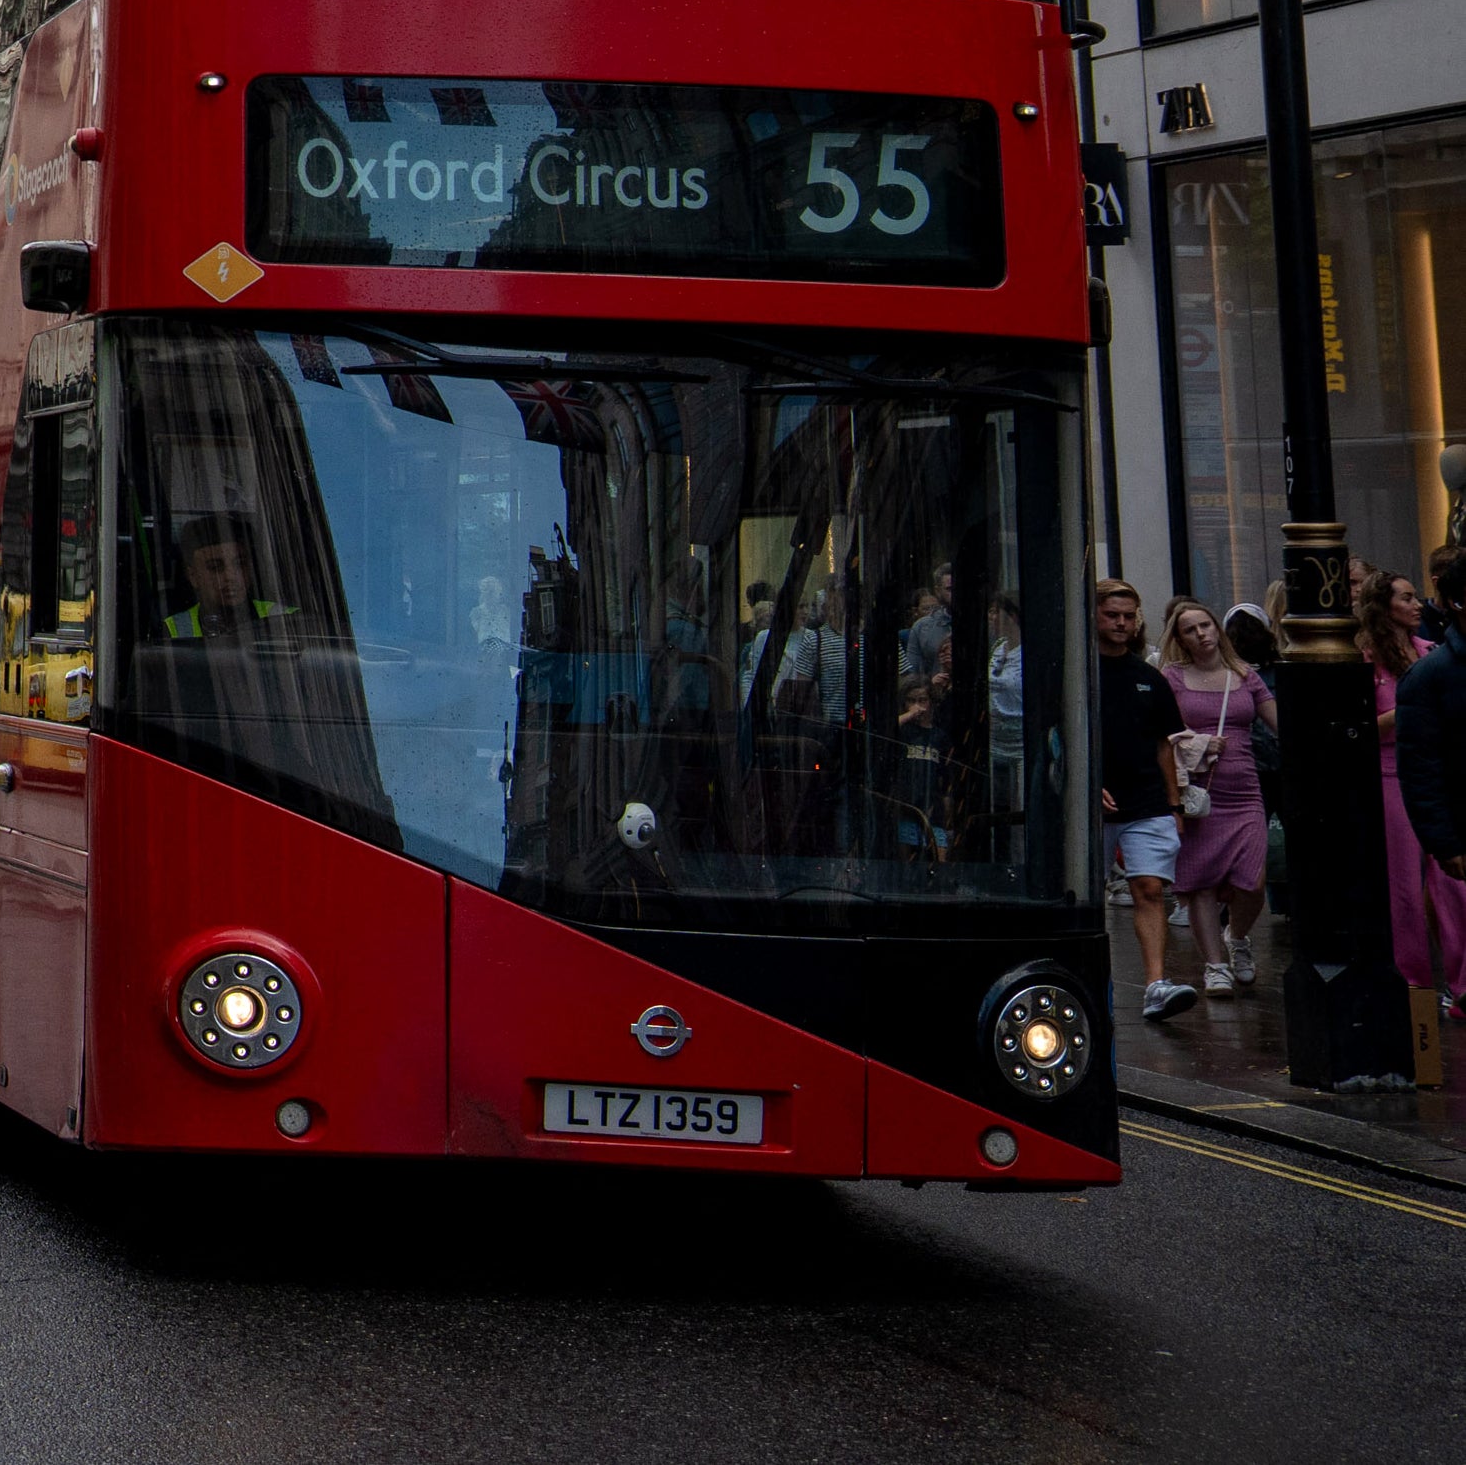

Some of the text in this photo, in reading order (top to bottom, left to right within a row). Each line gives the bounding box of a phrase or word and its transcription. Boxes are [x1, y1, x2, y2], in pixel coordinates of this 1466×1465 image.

[18, 142, 69, 206] Stagecoach
[298, 137, 709, 210] Oxford Circus
[799, 134, 932, 237] 55
[1085, 181, 1125, 227] RA
[1284, 435, 1294, 494] 107
[568, 1090, 739, 1135] LTZ 1359
